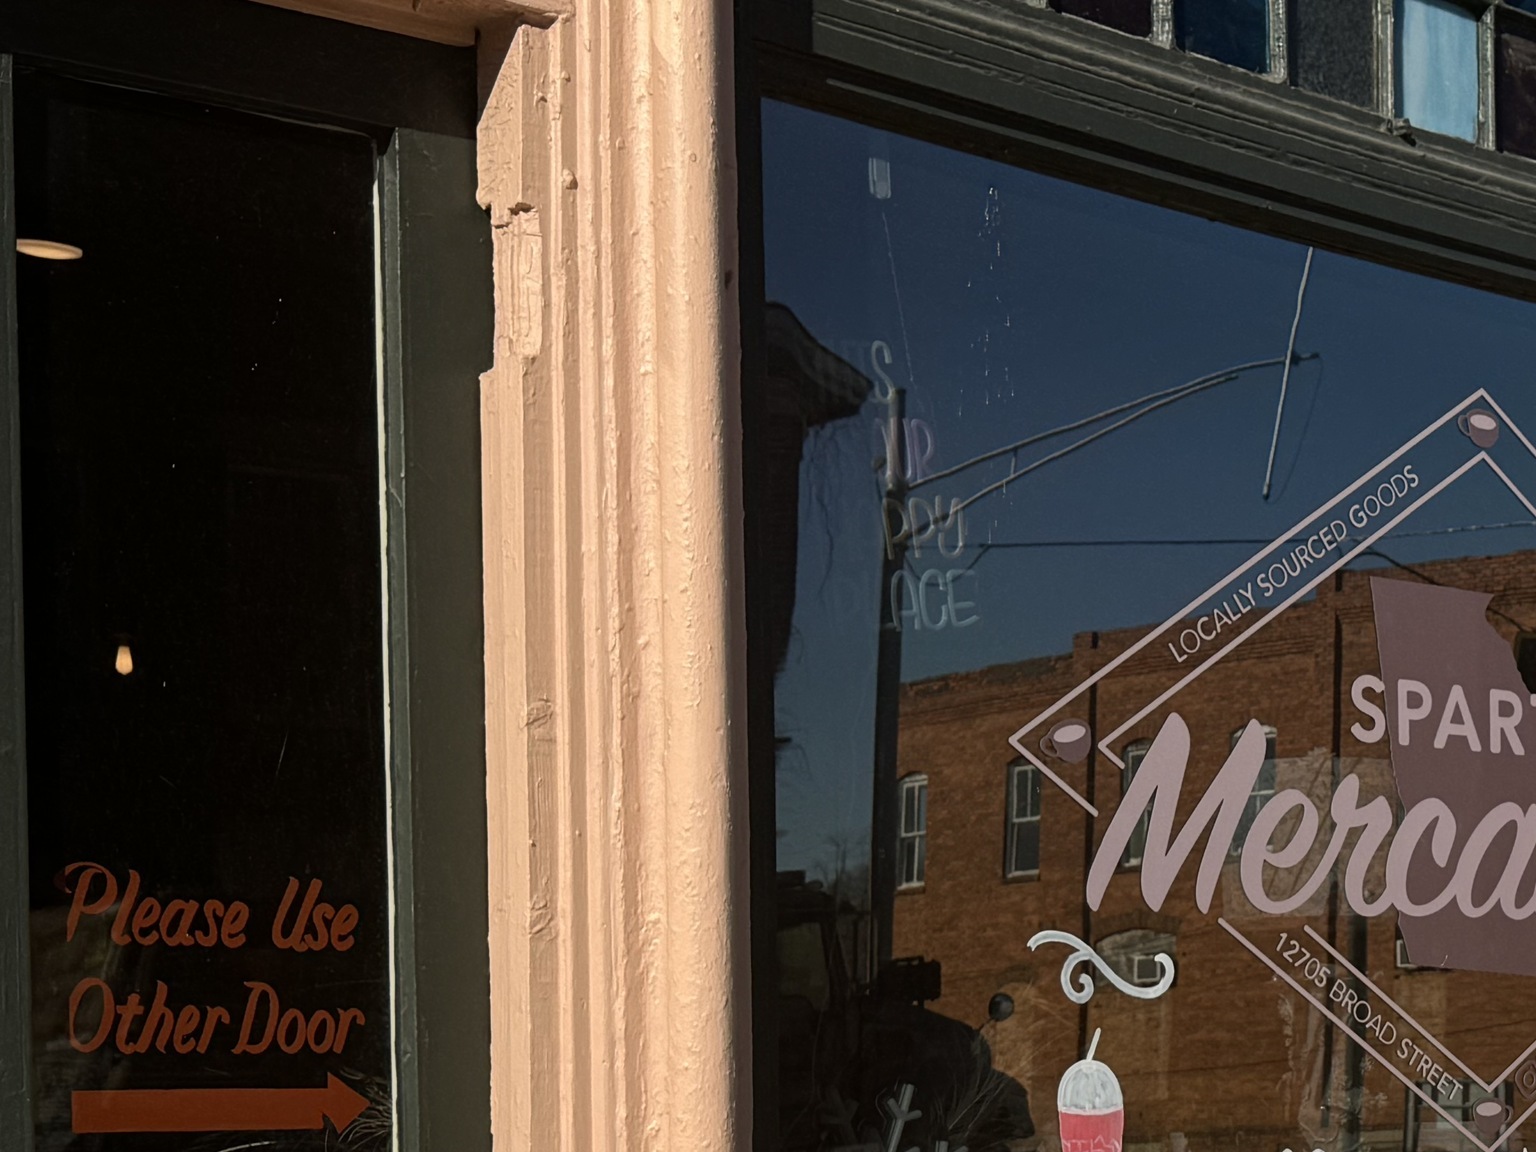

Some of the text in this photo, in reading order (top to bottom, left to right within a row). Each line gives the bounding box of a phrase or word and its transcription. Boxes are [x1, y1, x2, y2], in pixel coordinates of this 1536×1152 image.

[1168, 464, 1420, 664] LOCALLY SOURCED GOODS
[60, 861, 360, 952] Please Use
[68, 976, 366, 1055] Other Door
[1274, 931, 1464, 1101] 12705 BROAD STREET
